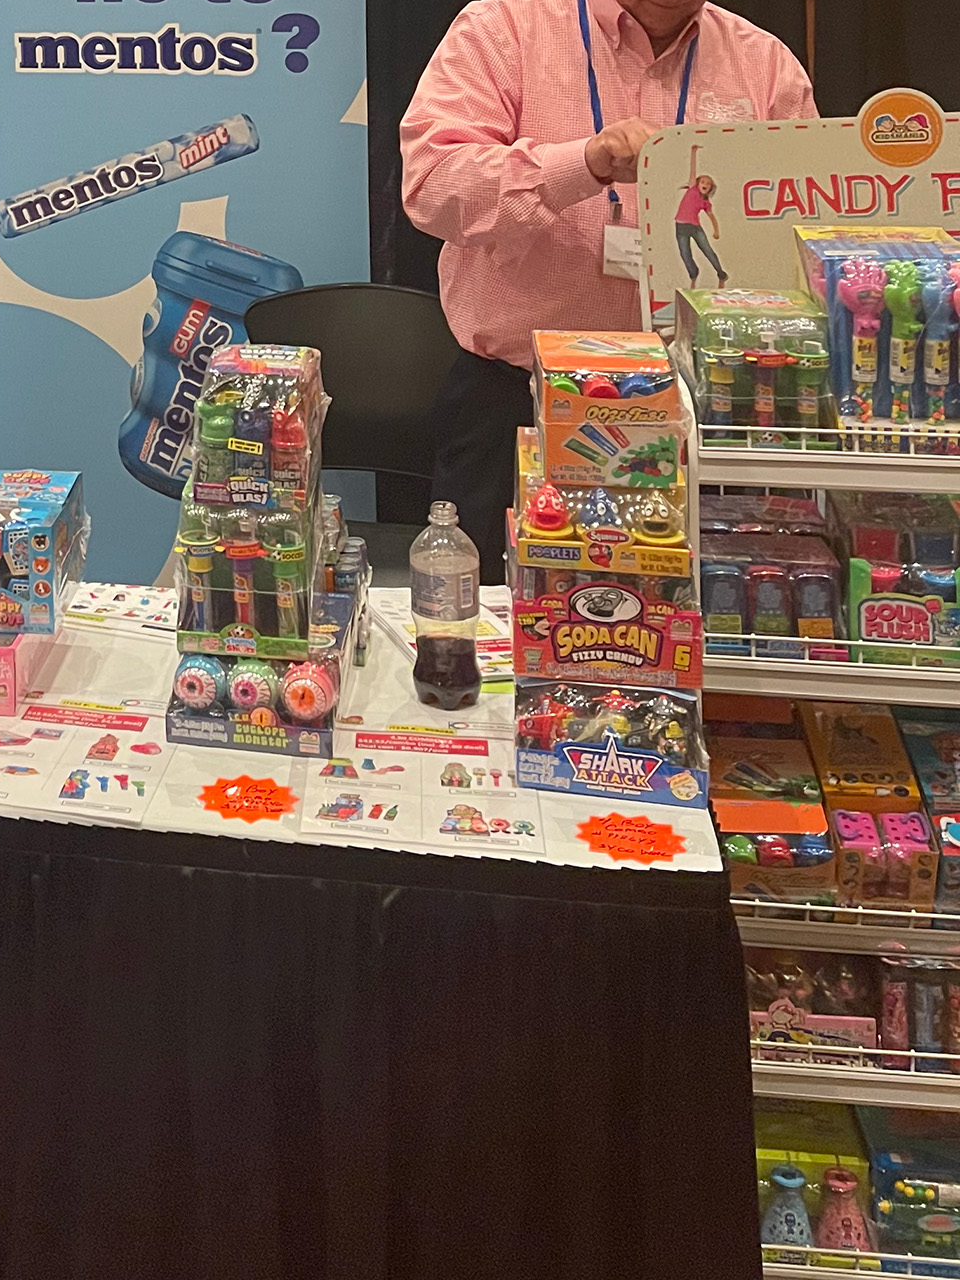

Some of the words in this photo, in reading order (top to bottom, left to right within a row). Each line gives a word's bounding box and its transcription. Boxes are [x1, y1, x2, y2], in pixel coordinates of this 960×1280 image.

[17, 26, 256, 73] mentos
[874, 131, 926, 142] KIDSMANIA
[8, 152, 163, 229] mentos
[180, 124, 232, 169] mint
[742, 173, 911, 219] CANDY
[147, 315, 233, 477] mentos
[230, 478, 269, 492] QUICK
[528, 546, 581, 560] POOPLETS
[864, 603, 929, 622] SOUR
[864, 620, 932, 642] FLUSH
[556, 624, 612, 658] SODA
[612, 624, 659, 662] CAN
[571, 650, 605, 662] FIZZY
[605, 649, 645, 666] CANDY
[674, 644, 692, 666] 6
[577, 746, 646, 776] SHARK
[577, 768, 648, 787] ATTACK
